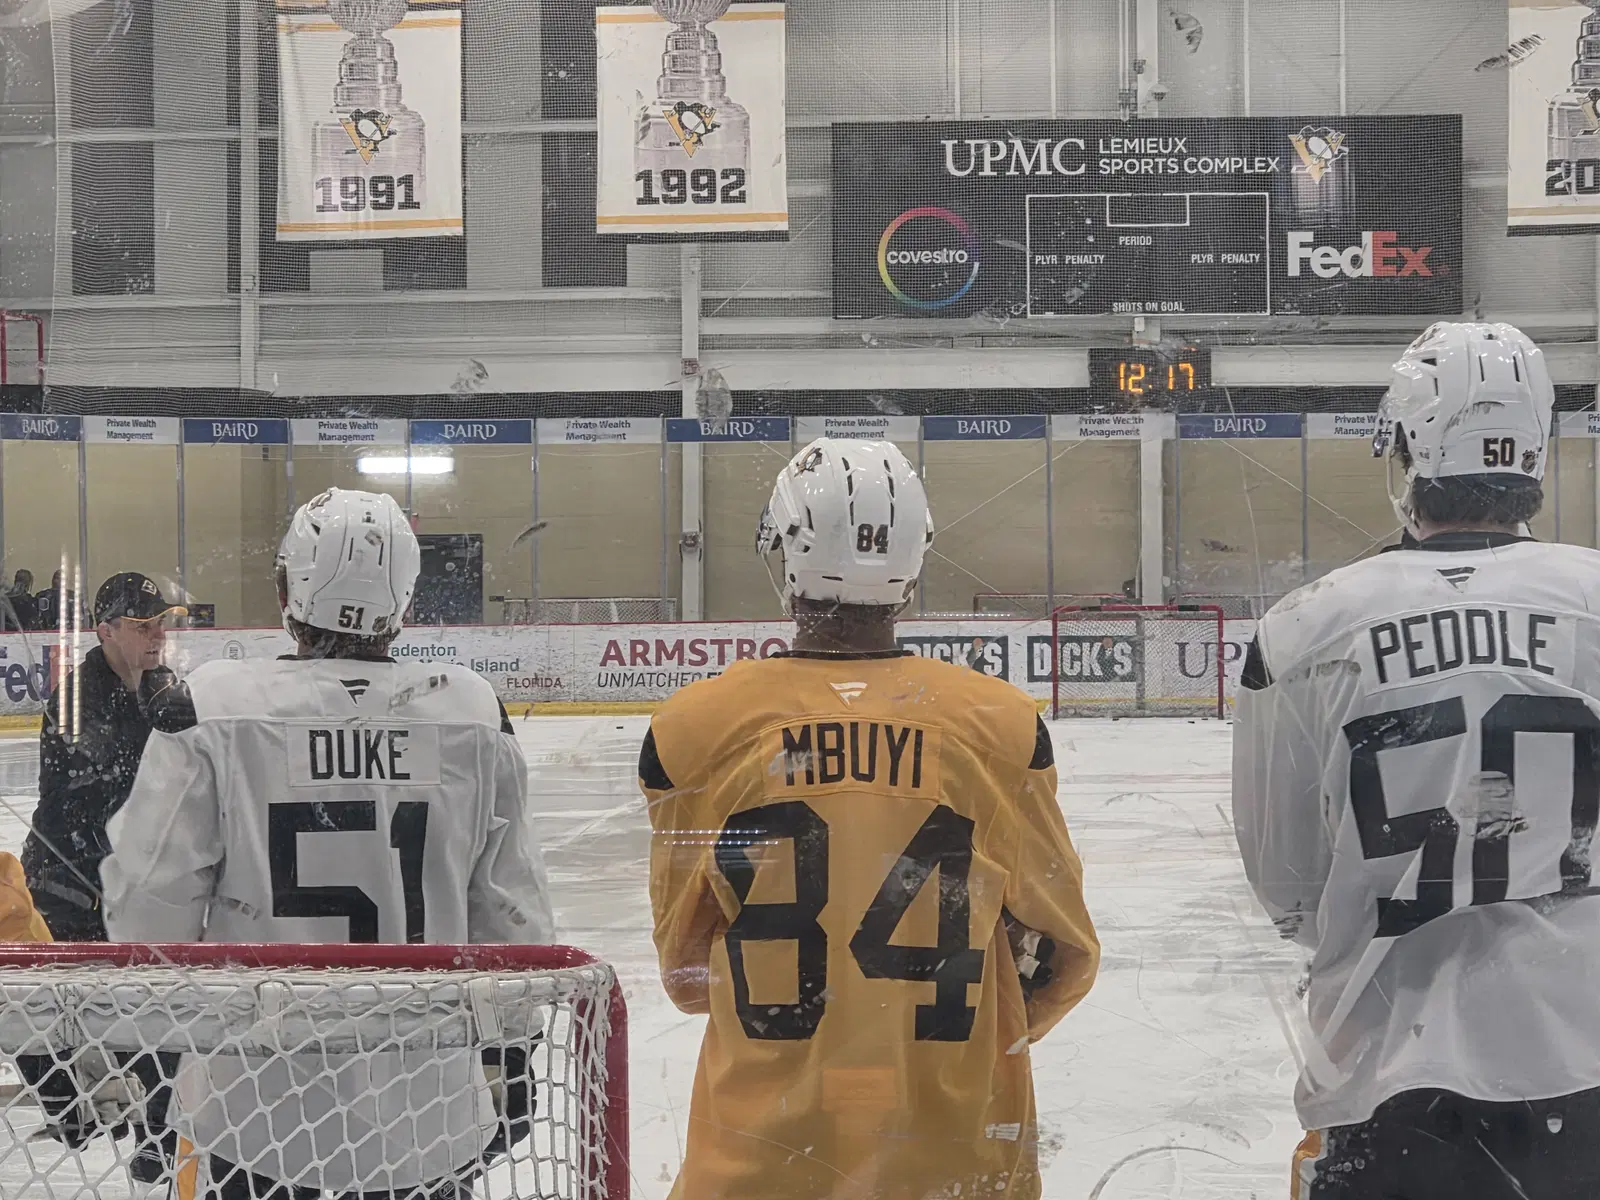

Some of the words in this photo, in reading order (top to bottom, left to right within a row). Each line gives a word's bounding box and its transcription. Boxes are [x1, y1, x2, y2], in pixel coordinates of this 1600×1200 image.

[1099, 137, 1187, 154] LEMIEUX
[941, 138, 1086, 177] UPMC
[1099, 158, 1179, 175] SPORTS
[1183, 156, 1281, 174] COMPLEX
[315, 174, 421, 213] 1991
[635, 167, 747, 206] 1992
[1118, 235, 1152, 247] PERIOD
[886, 247, 969, 265] covestro
[1035, 254, 1058, 265] PLYR
[1065, 253, 1105, 265] PENALTY
[1191, 253, 1214, 264] PLYR
[1221, 252, 1261, 264] PENALTY
[1287, 230, 1434, 279] FedEx
[1112, 301, 1142, 312] SHOTS
[1145, 301, 1159, 312] ON
[1160, 301, 1185, 312] GOAL
[1119, 362, 1194, 394] 12:17
[22, 419, 59, 437] BAIRD
[106, 418, 131, 430] Private
[132, 418, 157, 429] Wealth
[318, 421, 348, 431] Private
[350, 420, 379, 431] Wealth
[566, 420, 598, 430] Private
[599, 419, 631, 430] Wealth
[825, 418, 856, 428] Private
[857, 417, 889, 428] Wealth
[957, 419, 1011, 436] BAIRD
[1079, 415, 1112, 425] Private
[1113, 415, 1144, 425] Wealth
[1214, 417, 1267, 434] BAIRD
[1334, 415, 1366, 424] Private
[106, 430, 154, 442] Management
[212, 422, 259, 440] BAIRD
[318, 432, 375, 443] Management
[443, 423, 497, 440] BAIRD
[700, 420, 755, 438] BAIRD
[825, 429, 885, 440] Management
[1079, 427, 1141, 438] Management
[1334, 426, 1375, 437] Manage
[1483, 437, 1515, 468] 50
[856, 523, 889, 554] 84
[338, 604, 365, 631] 51
[1370, 608, 1557, 685] PEDDLE
[470, 658, 520, 673] Island
[1174, 641, 1252, 679] UP
[506, 677, 563, 689] FLORIDA
[308, 728, 411, 781] DUKE
[781, 721, 924, 790] MBUYI
[1342, 693, 1600, 938] 50
[268, 800, 429, 945] 51
[713, 800, 985, 1042] 84
